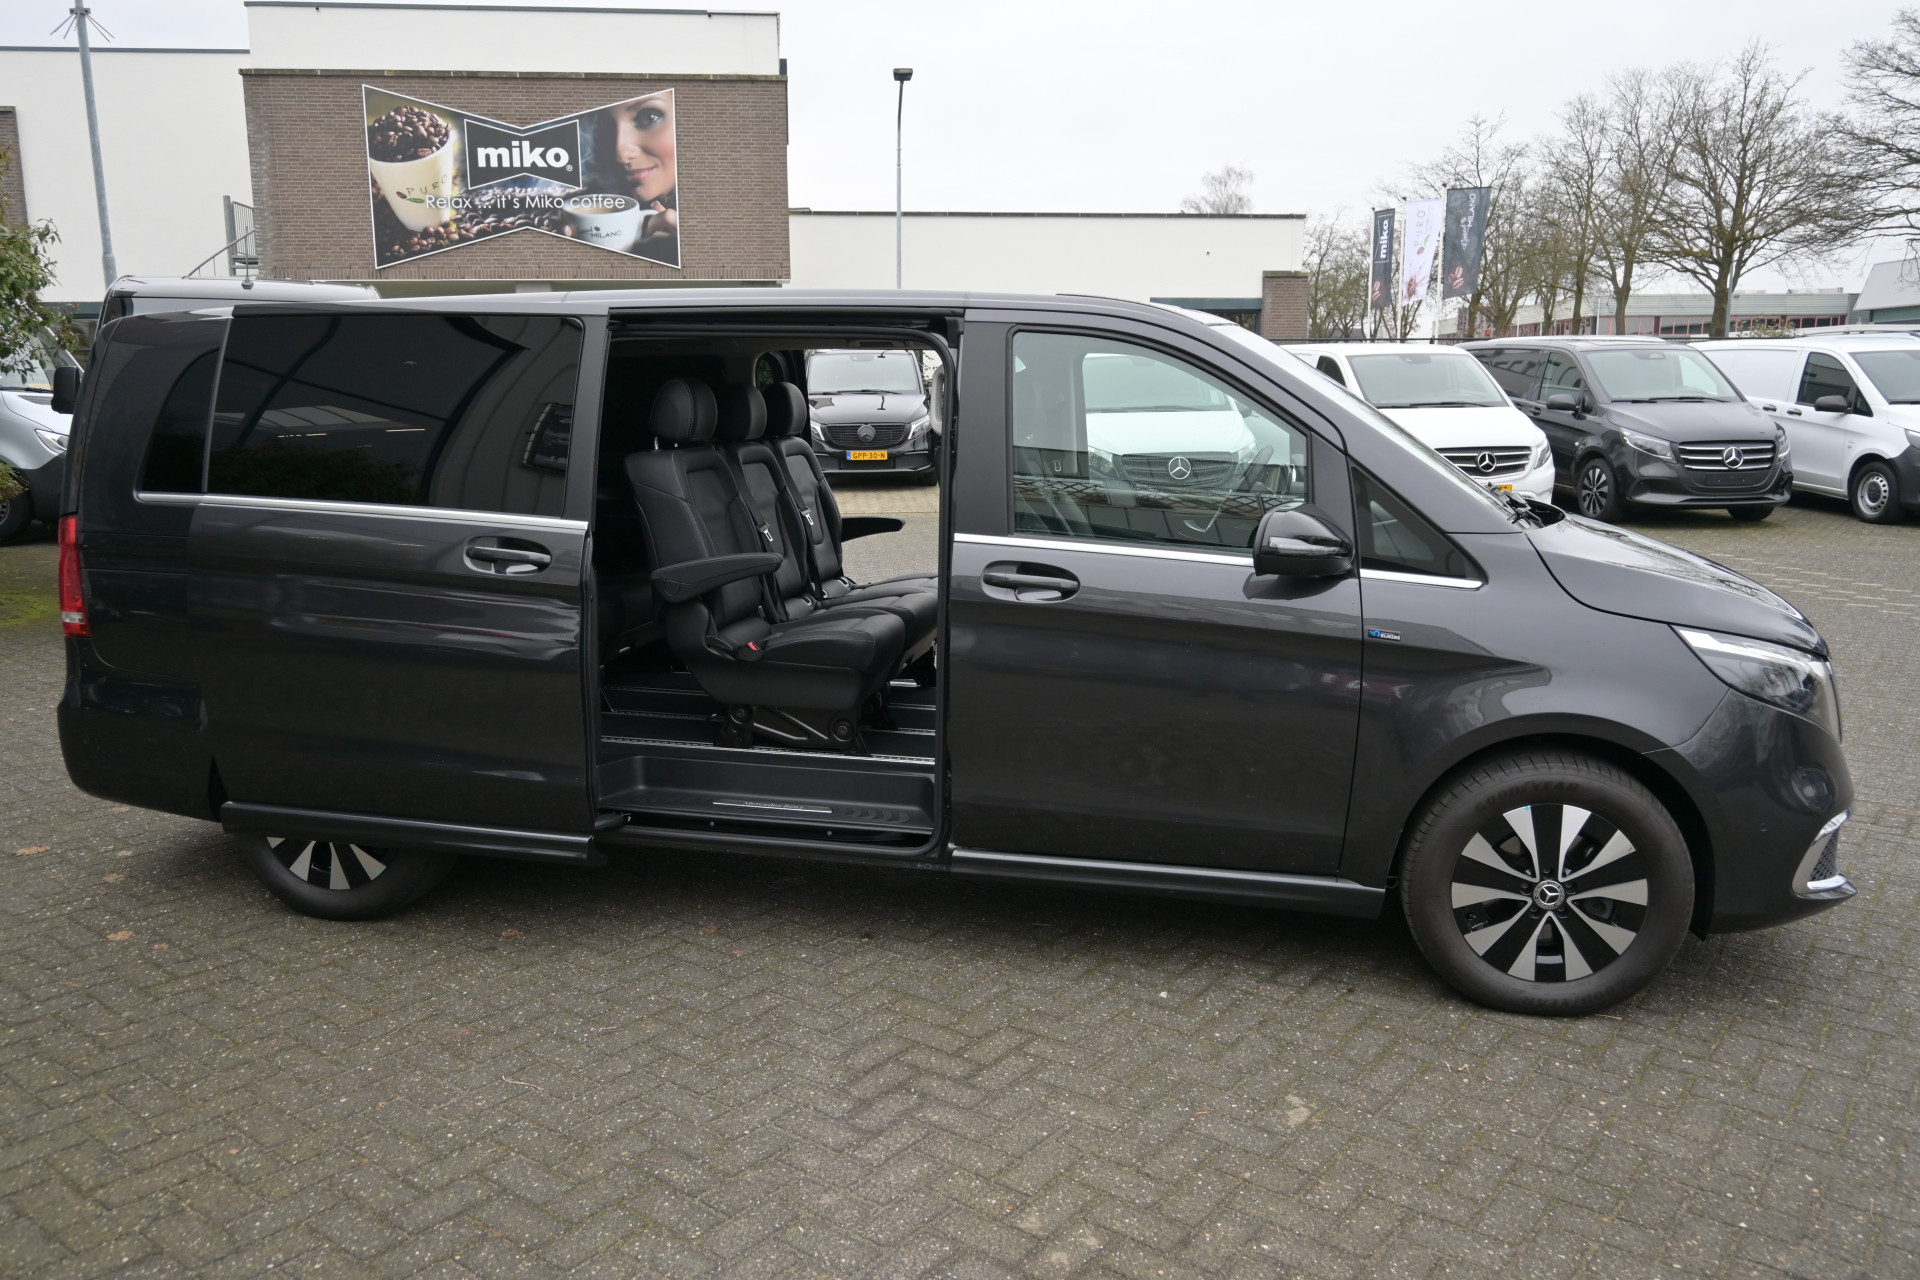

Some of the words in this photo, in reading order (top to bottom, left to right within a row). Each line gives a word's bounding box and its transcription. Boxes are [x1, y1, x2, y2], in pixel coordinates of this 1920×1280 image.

[477, 140, 569, 168] miko
[406, 174, 447, 196] PURO
[426, 194, 473, 209] Relax
[497, 195, 520, 209] it's
[525, 195, 564, 209] Miko
[570, 194, 626, 209] coffee
[1467, 193, 1476, 227] MILANO
[590, 230, 622, 239] MILANO
[1380, 220, 1389, 259] miko
[1414, 211, 1425, 246] PURO
[1475, 780, 1581, 812] GOODYEAR
